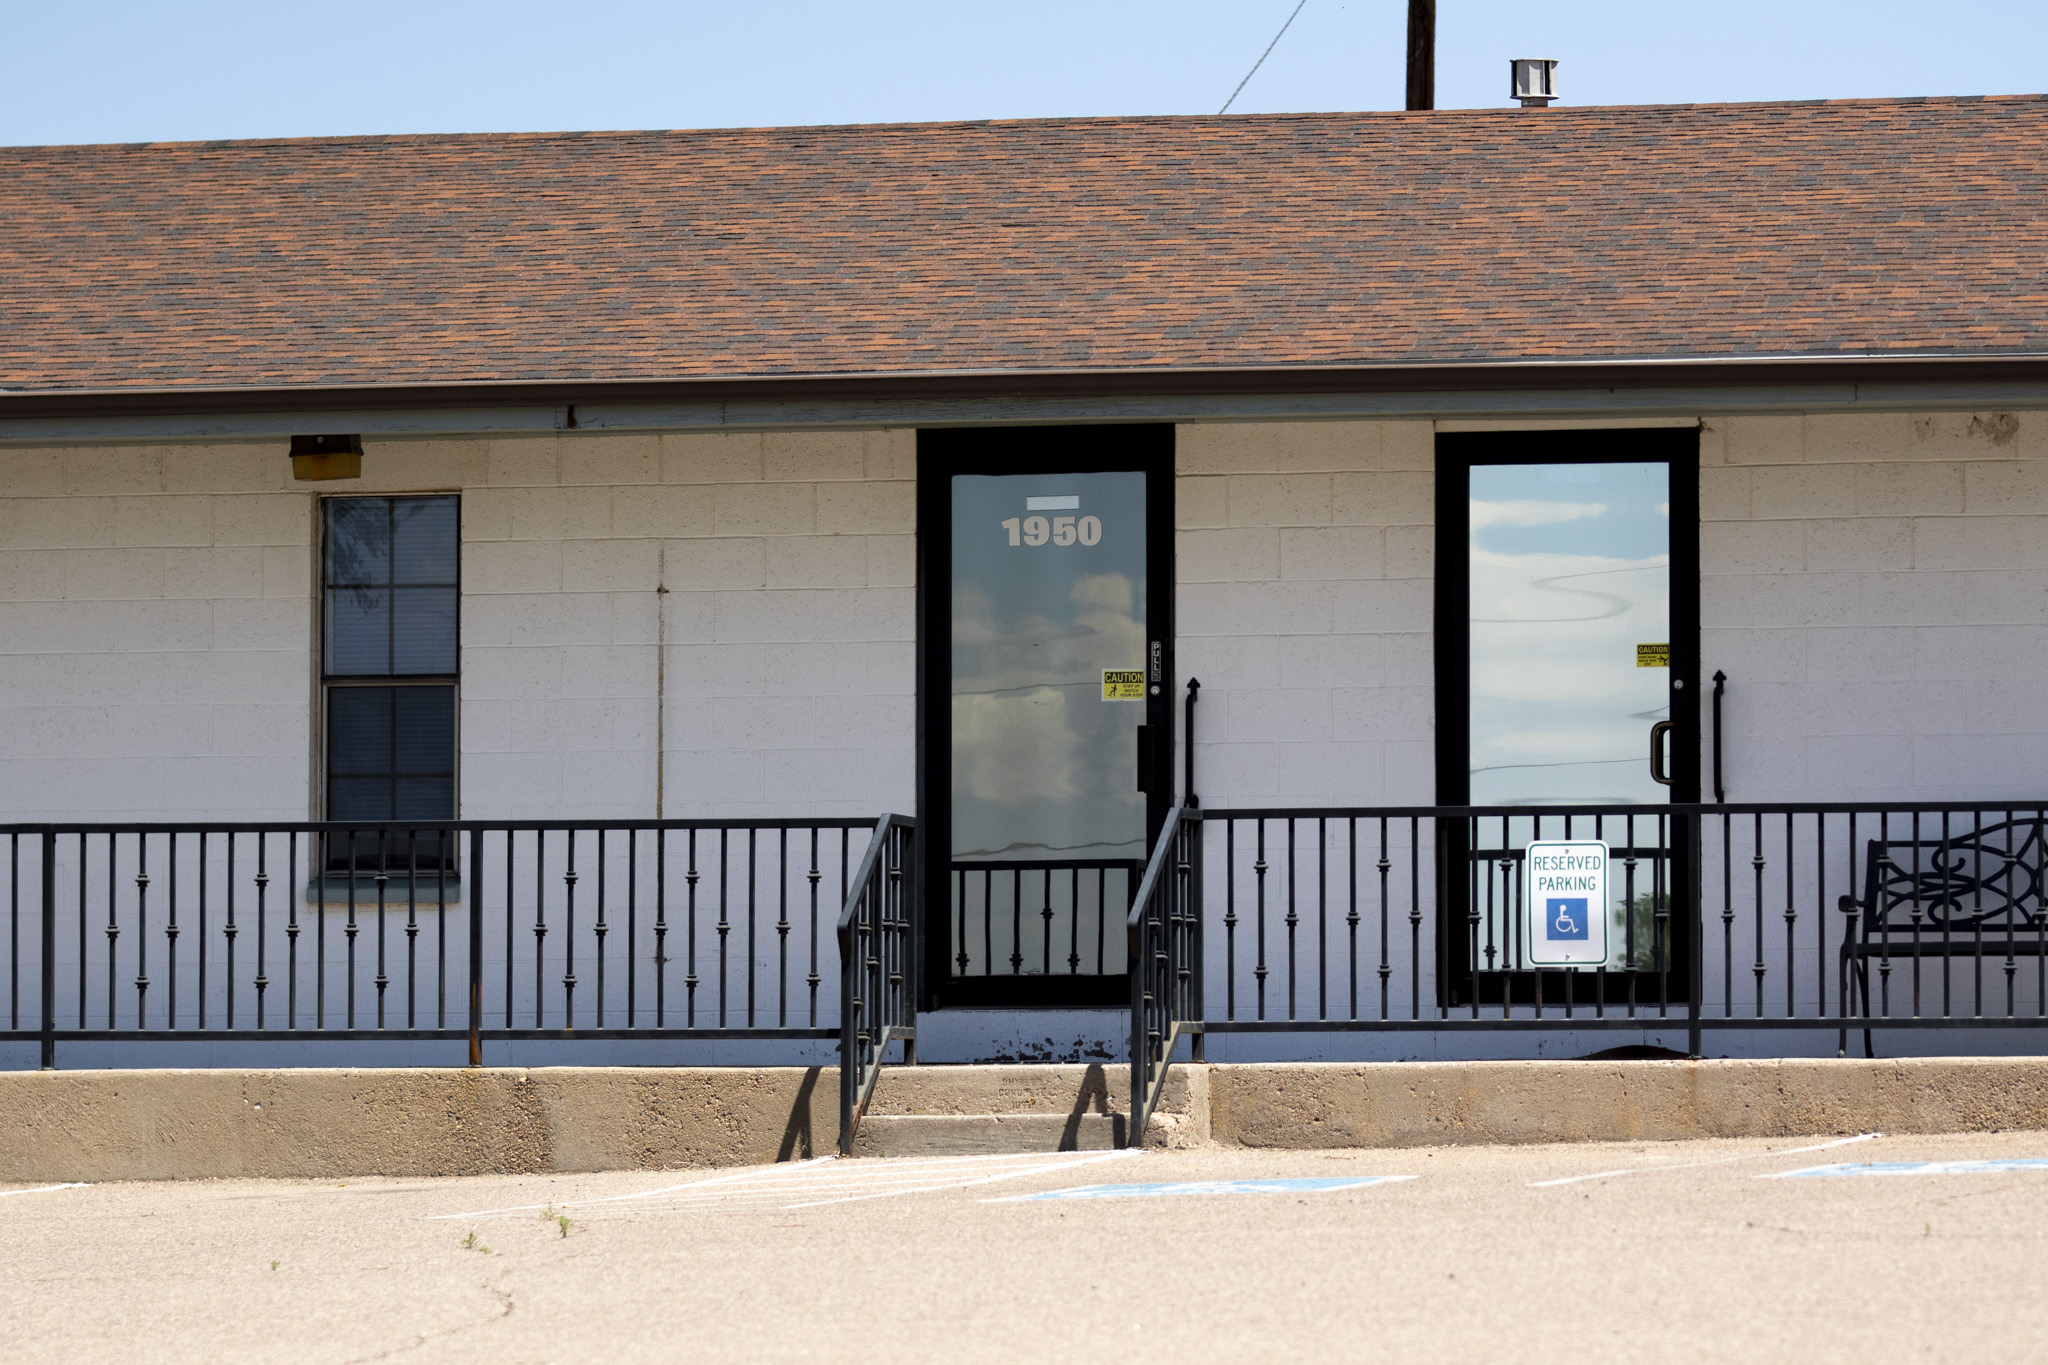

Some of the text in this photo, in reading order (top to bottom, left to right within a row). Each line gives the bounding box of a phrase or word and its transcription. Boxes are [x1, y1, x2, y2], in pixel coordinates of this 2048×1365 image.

[1001, 515, 1102, 546] 1950
[1638, 646, 1668, 654] CAUTION
[1105, 673, 1143, 682] CAUTION
[1534, 856, 1601, 870] RESERVED
[1539, 876, 1596, 891] PARKING
